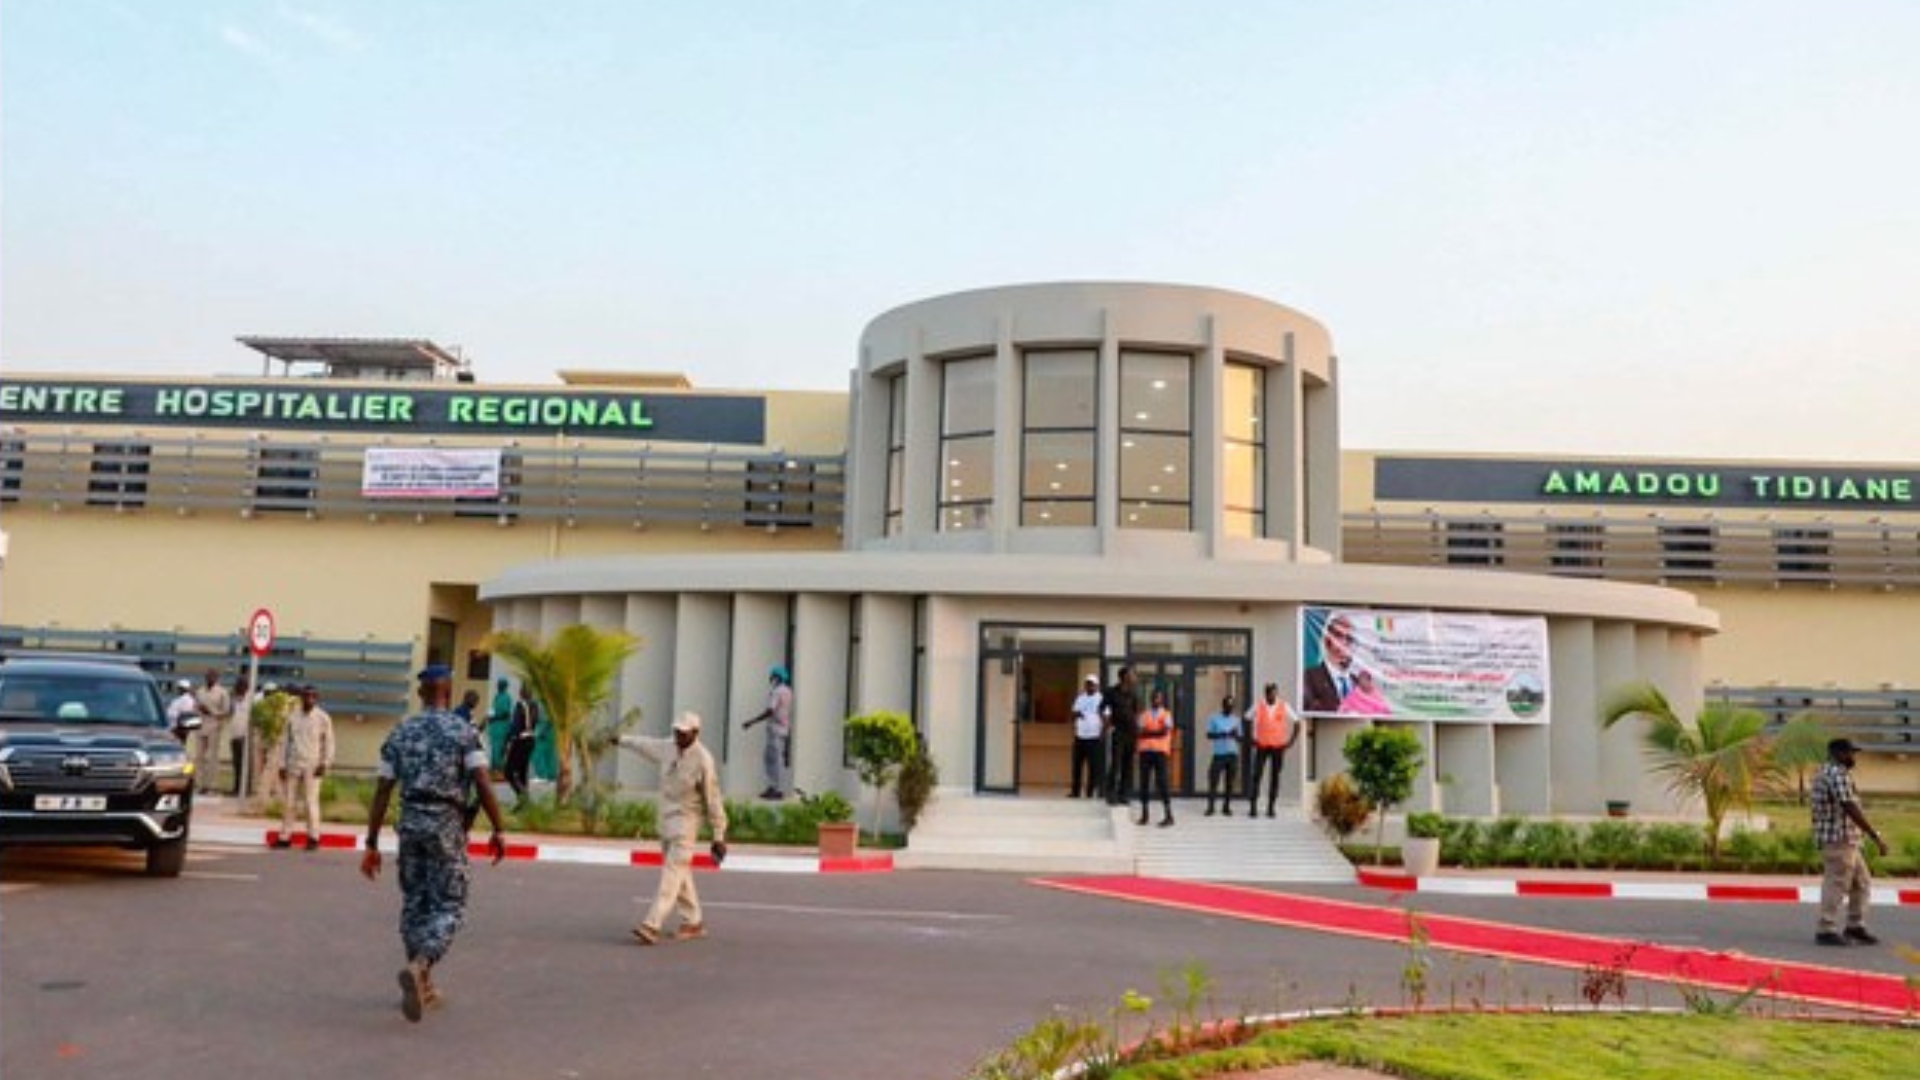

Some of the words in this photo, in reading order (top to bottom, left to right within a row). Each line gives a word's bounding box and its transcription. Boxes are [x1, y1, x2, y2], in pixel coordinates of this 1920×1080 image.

[0, 386, 124, 413] ENTRE
[155, 389, 414, 420] HOSPITALIER
[449, 397, 653, 426] REGIONAL
[1544, 470, 1722, 497] AMADOU
[1752, 476, 1914, 502] TIDIANE
